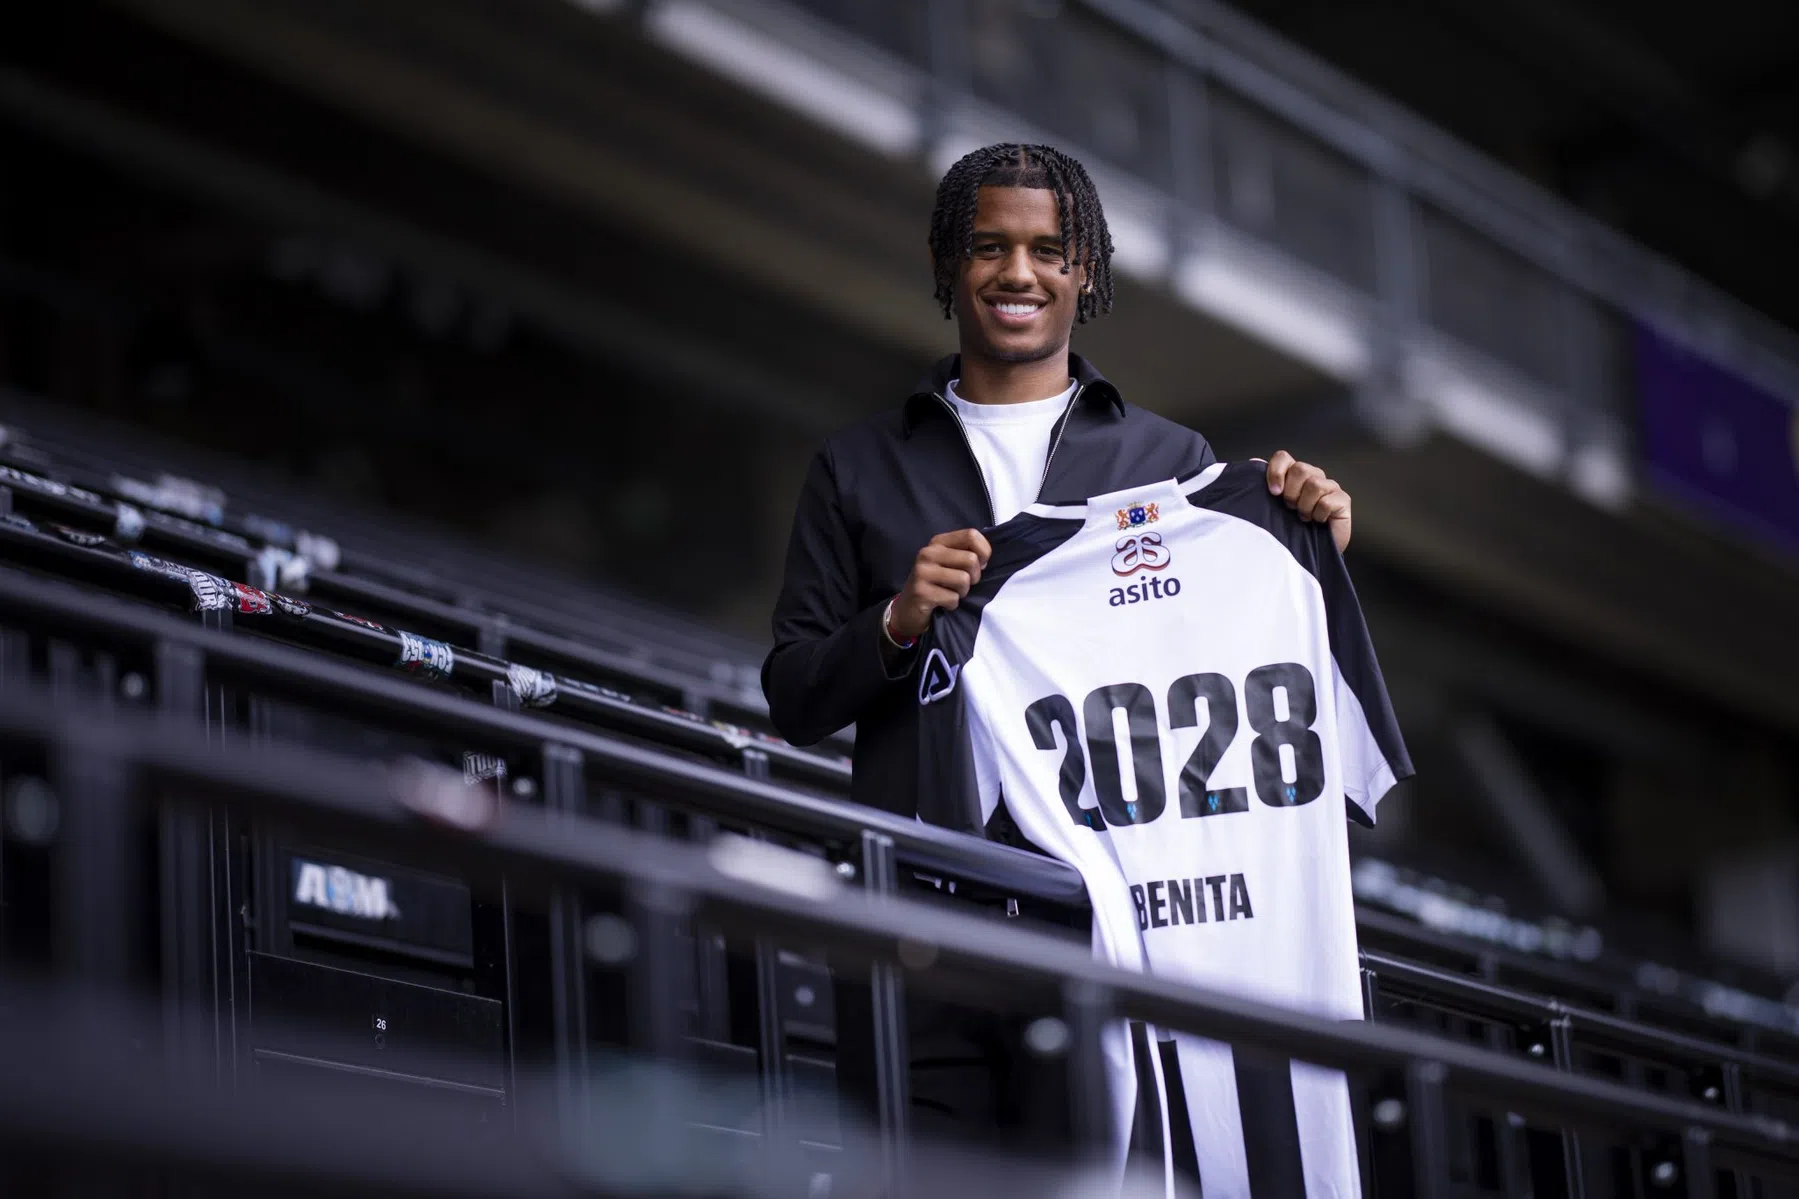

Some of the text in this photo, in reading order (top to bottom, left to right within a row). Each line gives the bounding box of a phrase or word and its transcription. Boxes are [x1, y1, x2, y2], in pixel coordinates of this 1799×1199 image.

[1109, 576, 1181, 607] asito
[1025, 662, 1325, 832] 2028
[1129, 872, 1254, 931] BENITA
[376, 1018, 387, 1030] 26
